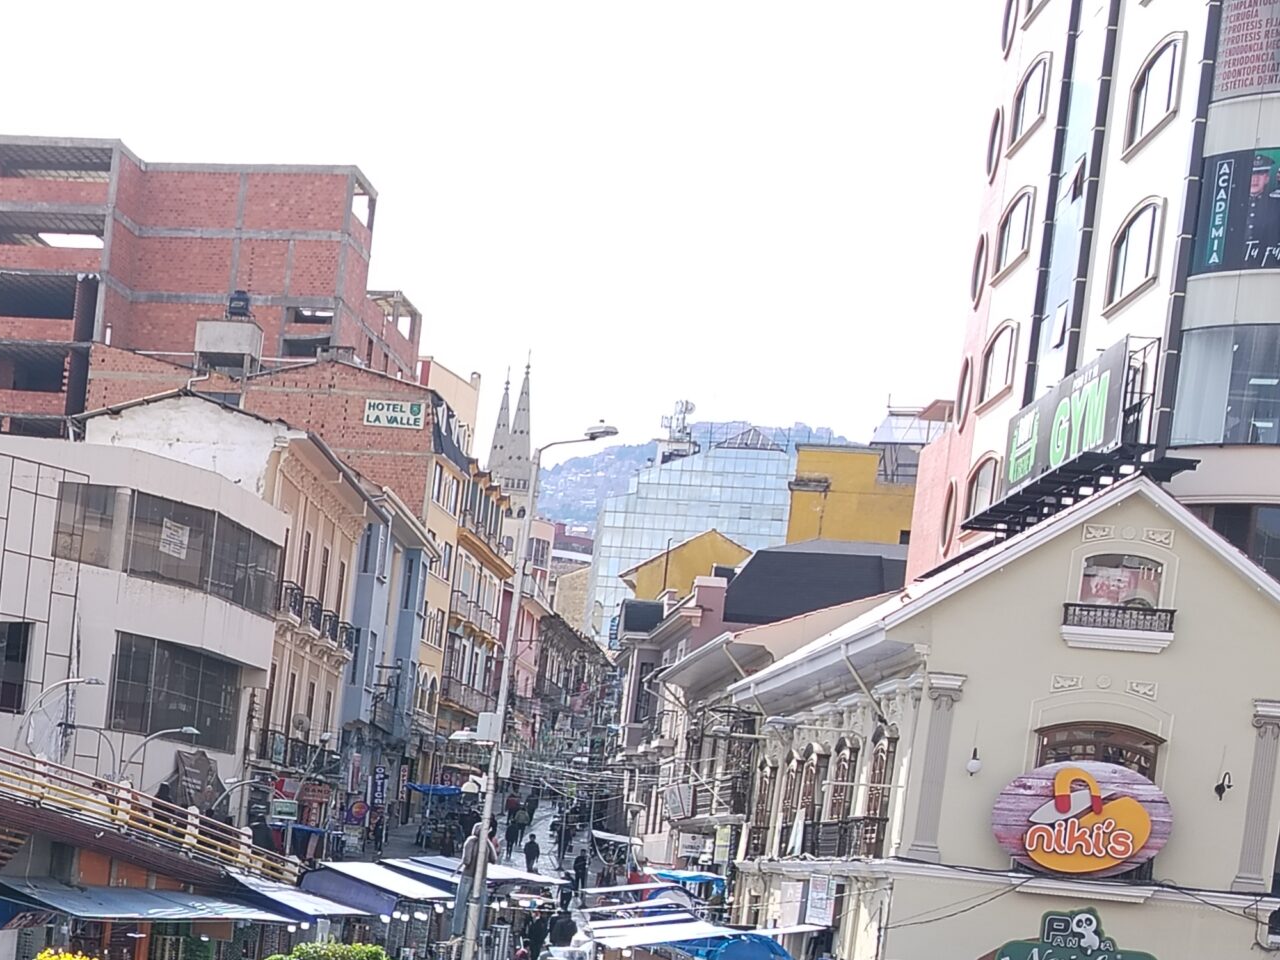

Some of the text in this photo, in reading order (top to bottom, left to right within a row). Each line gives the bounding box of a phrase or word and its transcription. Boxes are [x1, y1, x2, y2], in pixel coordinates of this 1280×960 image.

[1223, 51, 1275, 69] PERIODONCIA
[1208, 162, 1230, 264] ACADEMIA
[1244, 240, 1260, 261] Tu
[367, 402, 406, 413] HOTEL
[366, 414, 421, 427] LA VALLE
[1049, 369, 1111, 469] GYM
[1025, 818, 1133, 859] niki's
